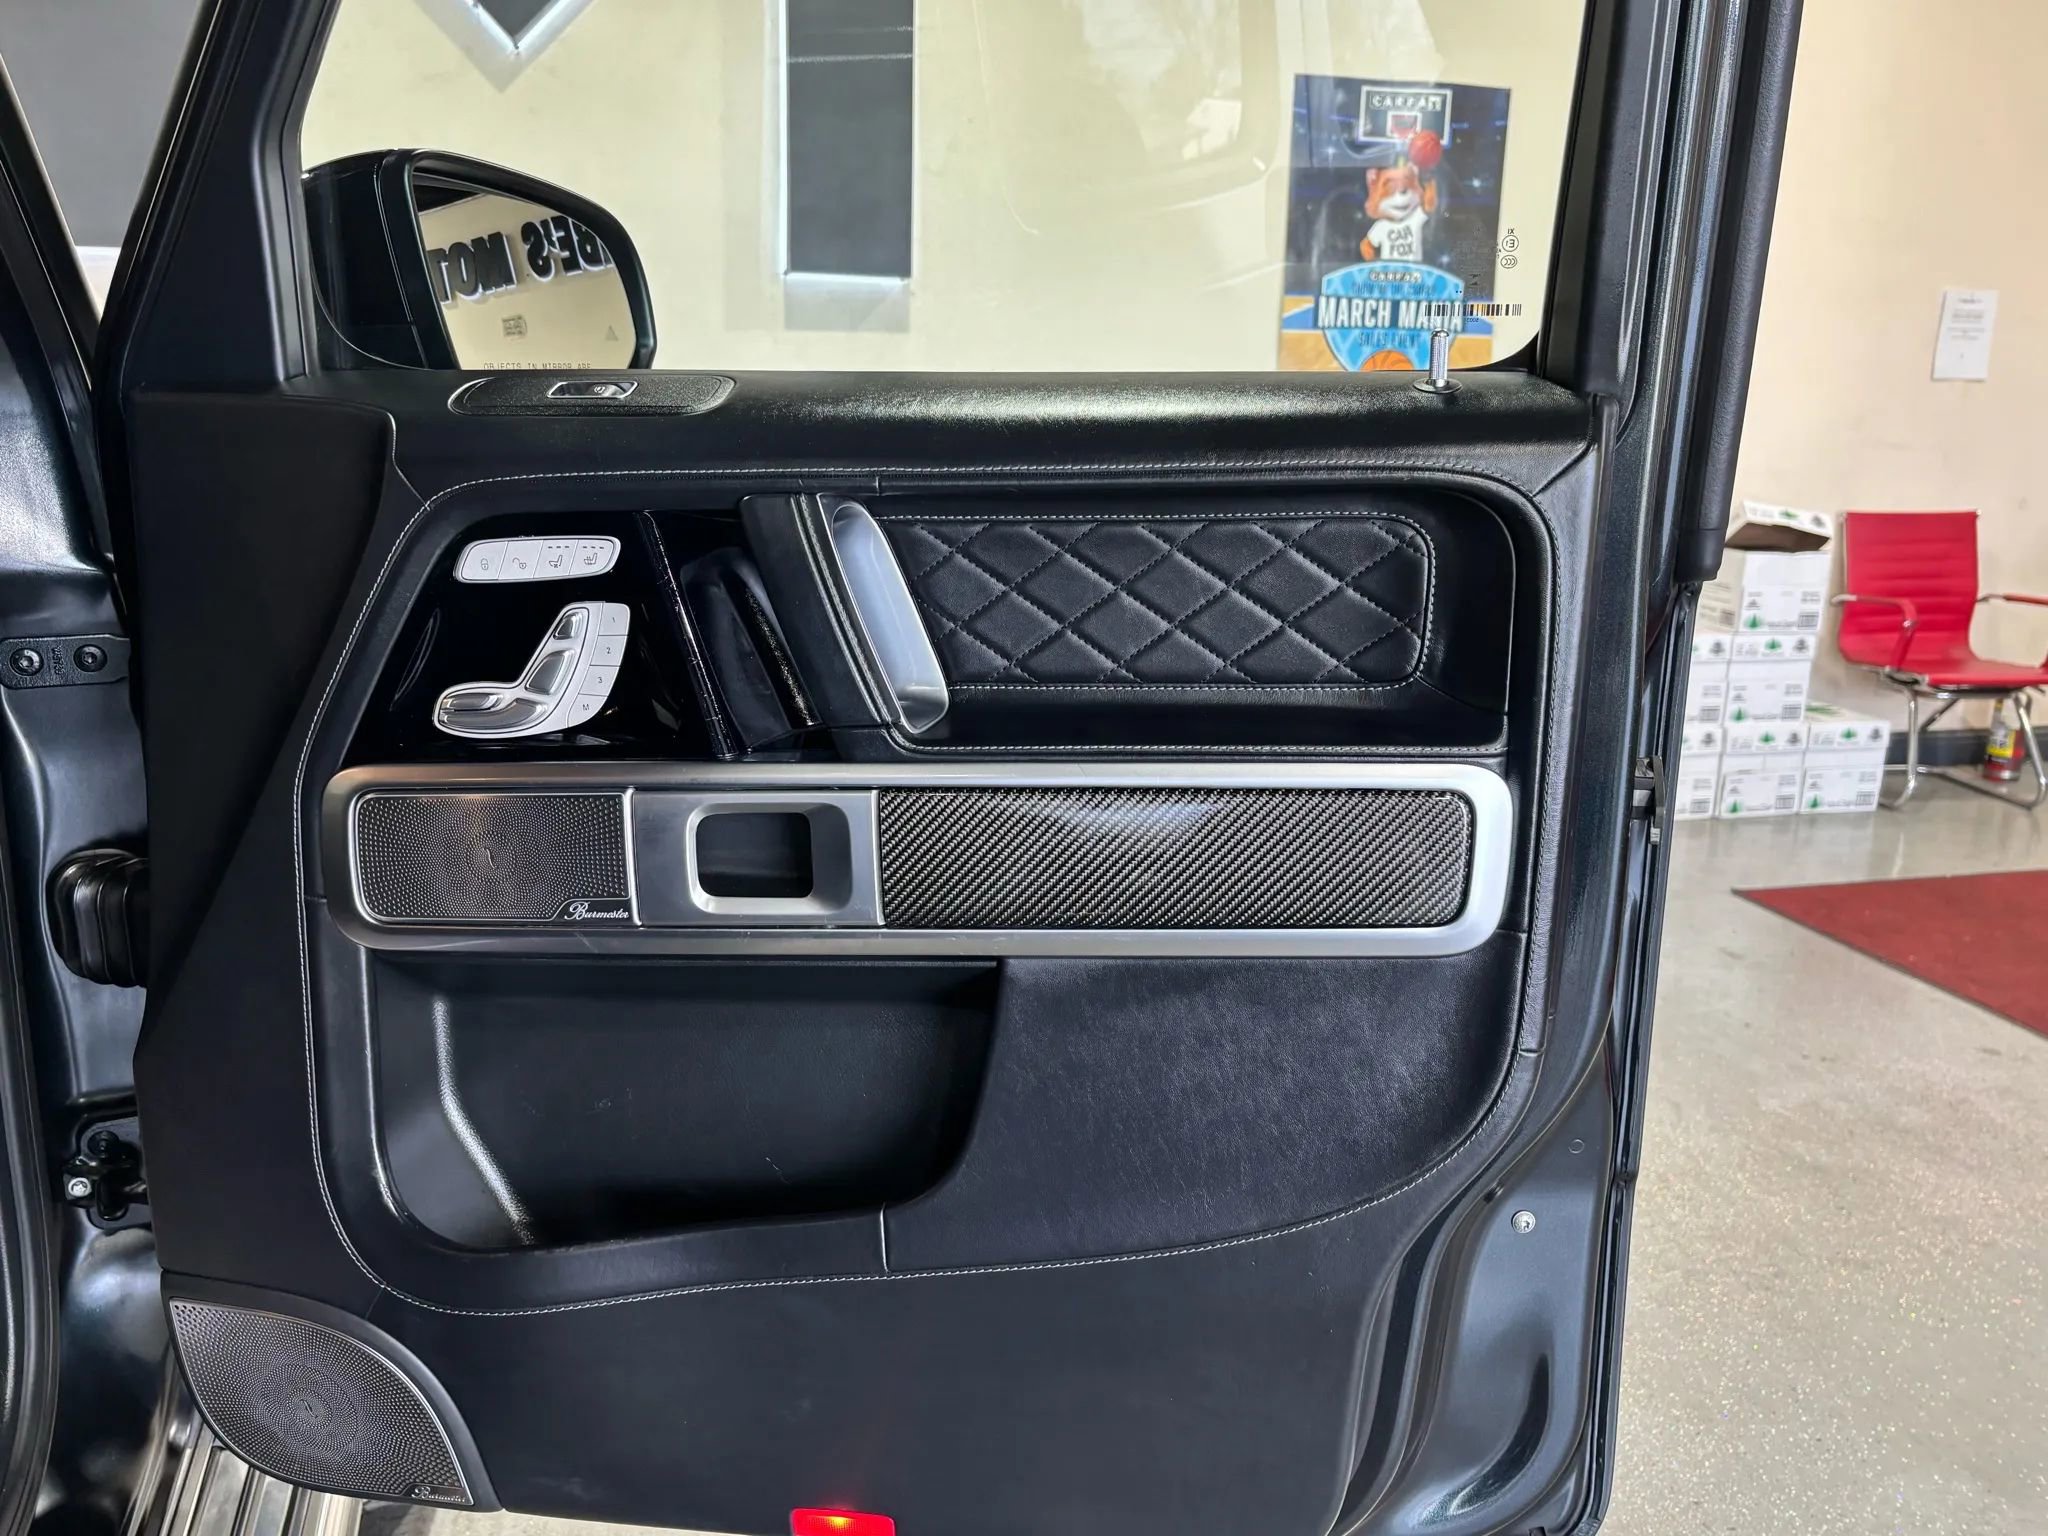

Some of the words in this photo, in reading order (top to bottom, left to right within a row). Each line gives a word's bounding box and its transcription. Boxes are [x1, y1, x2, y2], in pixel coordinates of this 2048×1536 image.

[1317, 295, 1392, 329] MARCH
[1397, 299, 1463, 333] MANIA
[582, 703, 590, 711] M
[564, 901, 629, 920] Burmester
